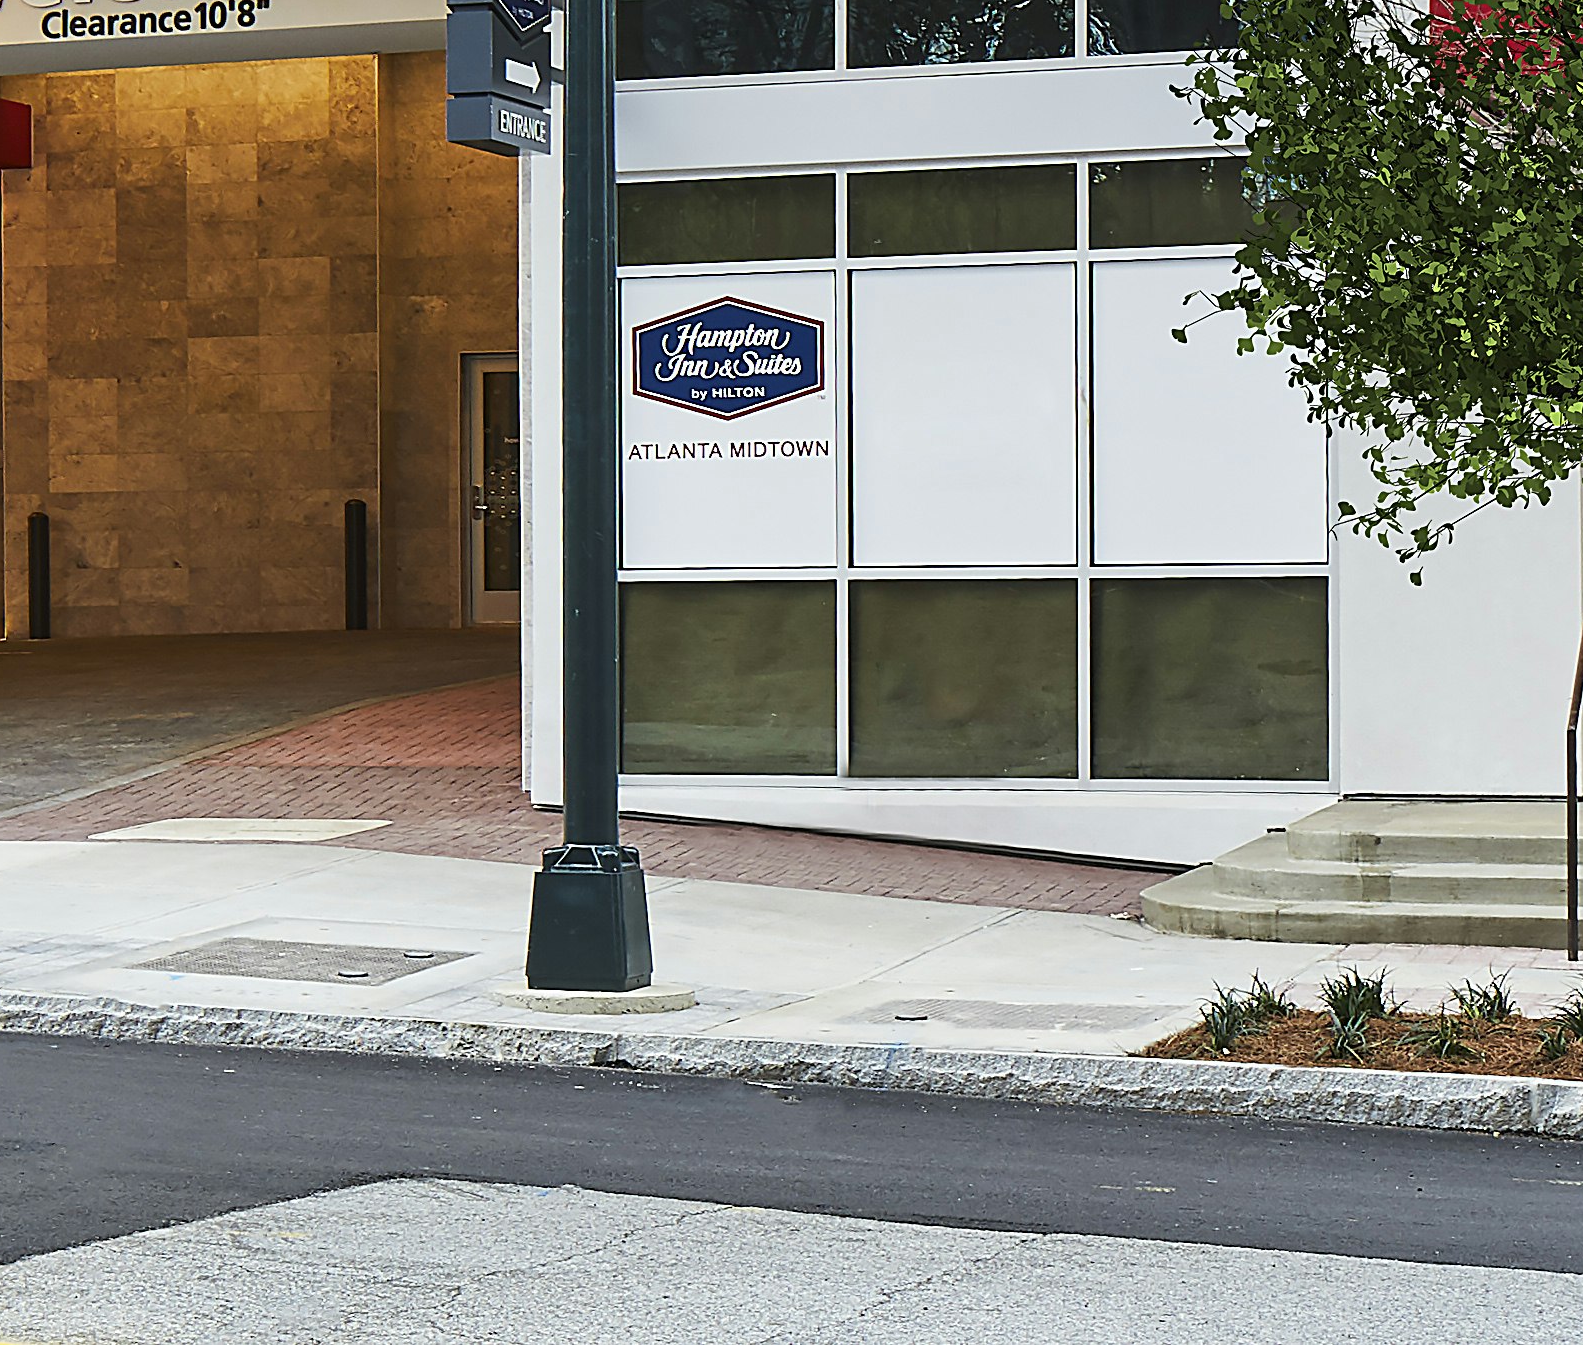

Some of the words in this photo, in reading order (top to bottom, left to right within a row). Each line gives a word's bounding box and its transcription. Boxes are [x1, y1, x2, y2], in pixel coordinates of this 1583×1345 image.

[41, 9, 192, 39] Clearance
[500, 110, 547, 144] ENTRANCE
[662, 322, 790, 356] Hampton
[654, 353, 719, 382] Inn
[718, 360, 737, 379] &
[734, 351, 802, 376] Suites
[691, 388, 708, 401] by
[712, 387, 765, 399] HILTON
[629, 442, 723, 460] ATLANTA
[730, 440, 829, 458] MIDTOWN
